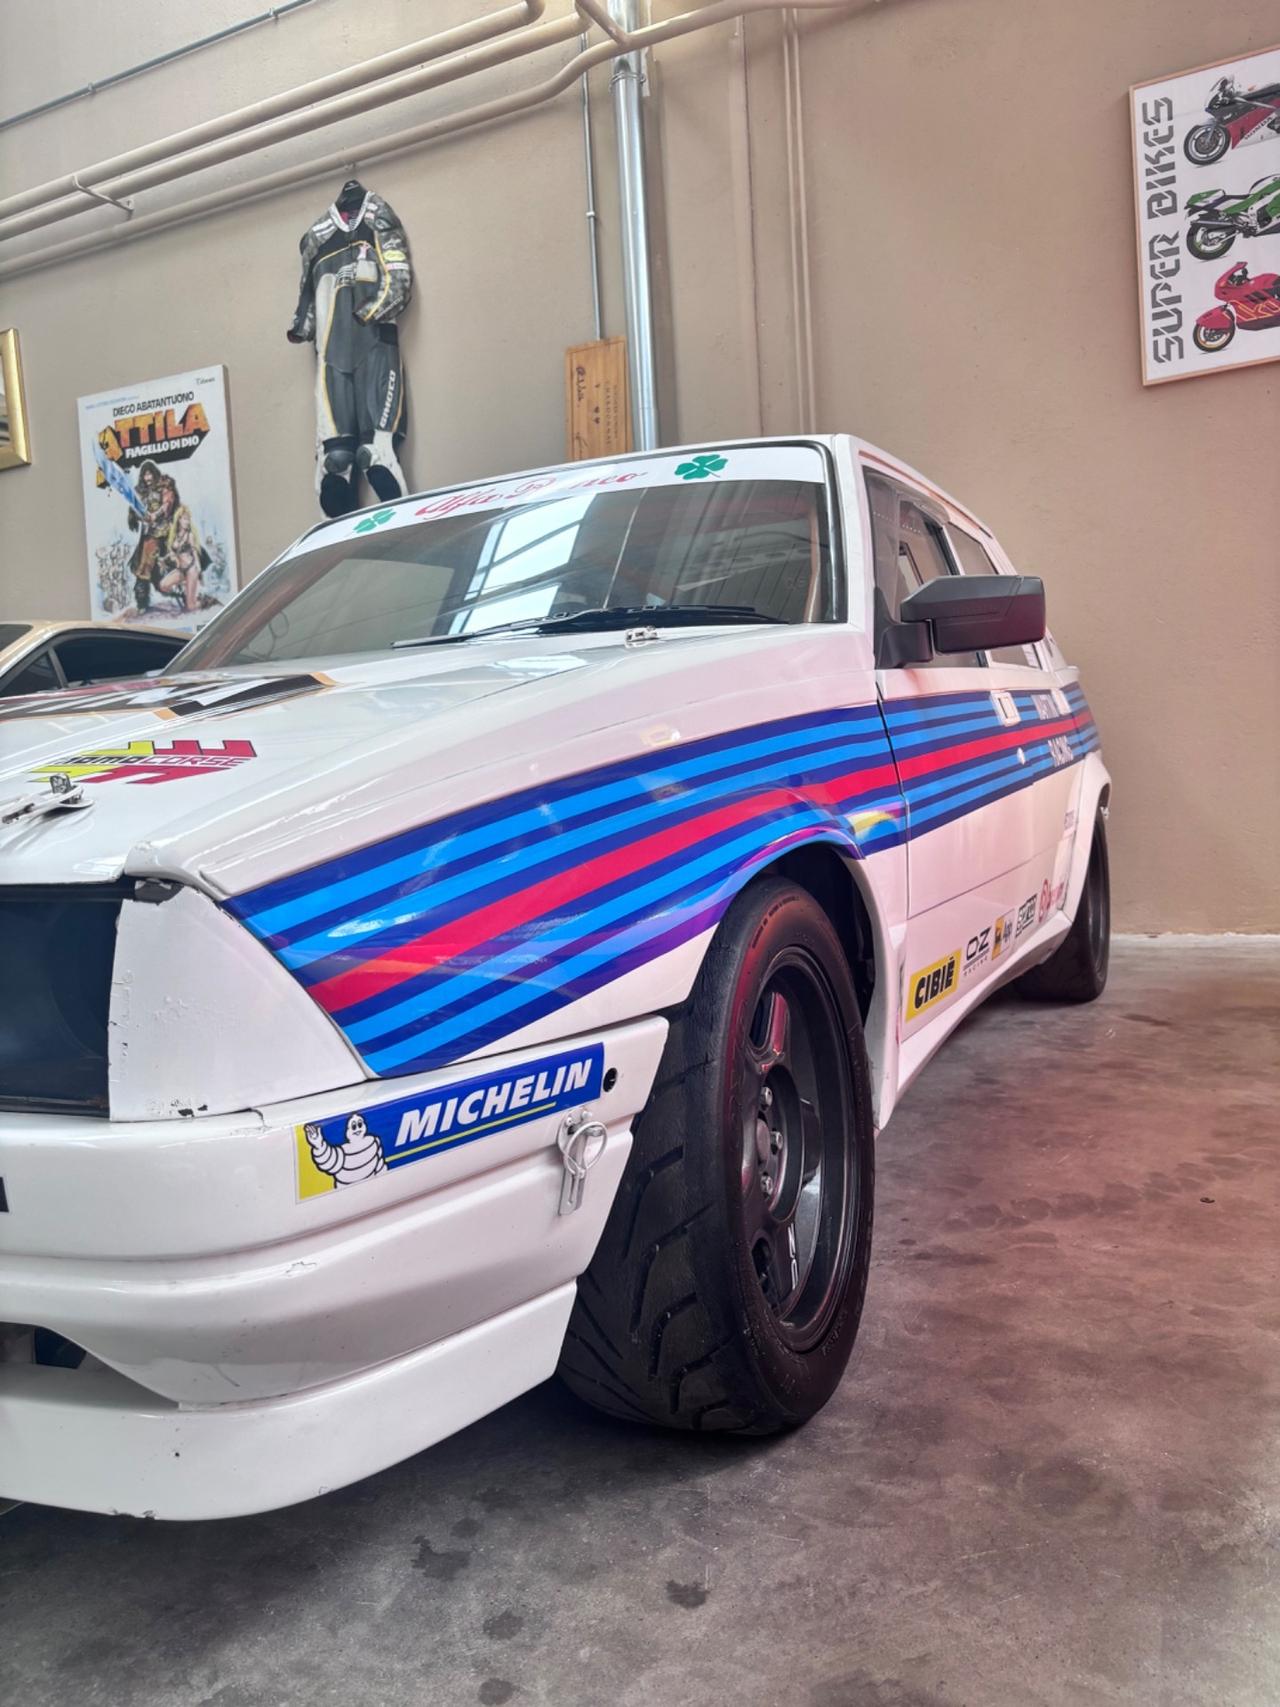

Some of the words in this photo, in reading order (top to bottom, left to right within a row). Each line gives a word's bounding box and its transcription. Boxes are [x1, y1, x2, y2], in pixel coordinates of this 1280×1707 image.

[1142, 96, 1180, 220] BIKES
[1148, 230, 1185, 363] SUPER
[98, 402, 210, 462] ATTILA
[112, 404, 136, 417] DIEGO
[136, 390, 195, 412] ABATANTUONO
[170, 438, 180, 450] DI
[181, 434, 200, 448] DIO
[966, 925, 993, 961] OZ
[394, 1058, 593, 1148] MICHELIN
